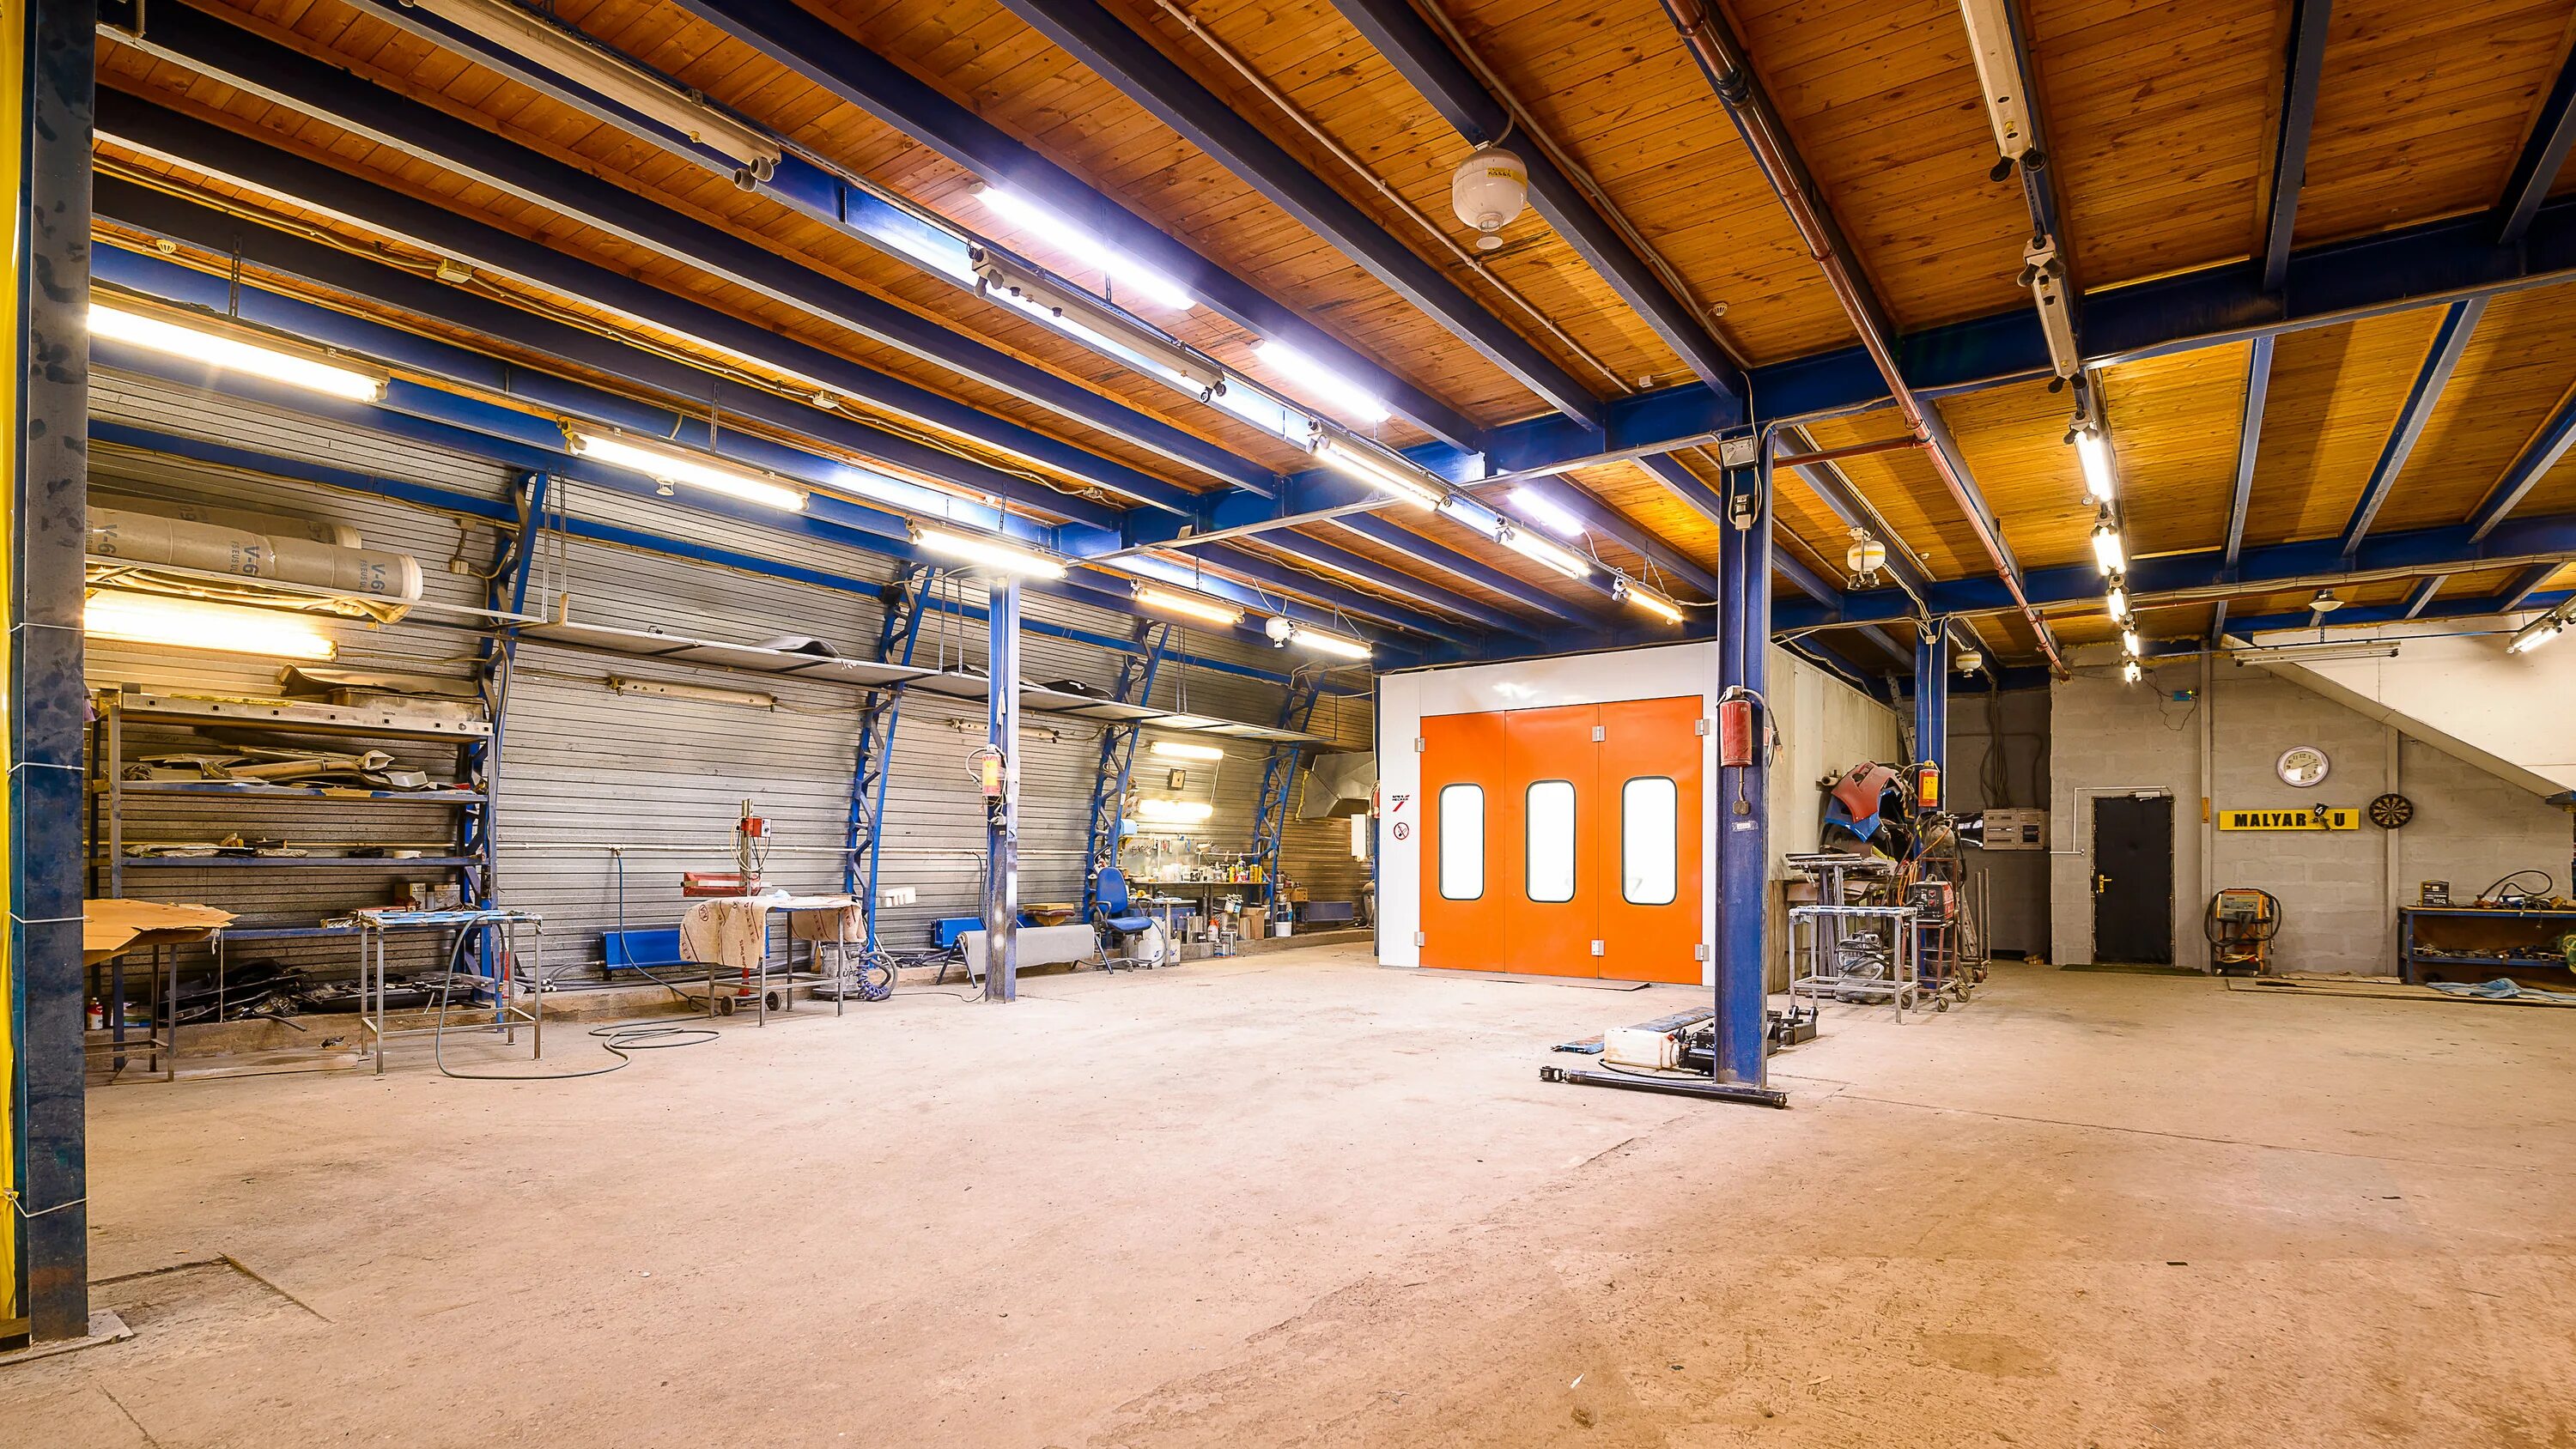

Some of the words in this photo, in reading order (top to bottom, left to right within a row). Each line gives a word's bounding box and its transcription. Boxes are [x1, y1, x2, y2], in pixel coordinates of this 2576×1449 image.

[243, 546, 260, 574] V-6
[2234, 813, 2306, 827] MALYAR
[2334, 813, 2345, 826] U
